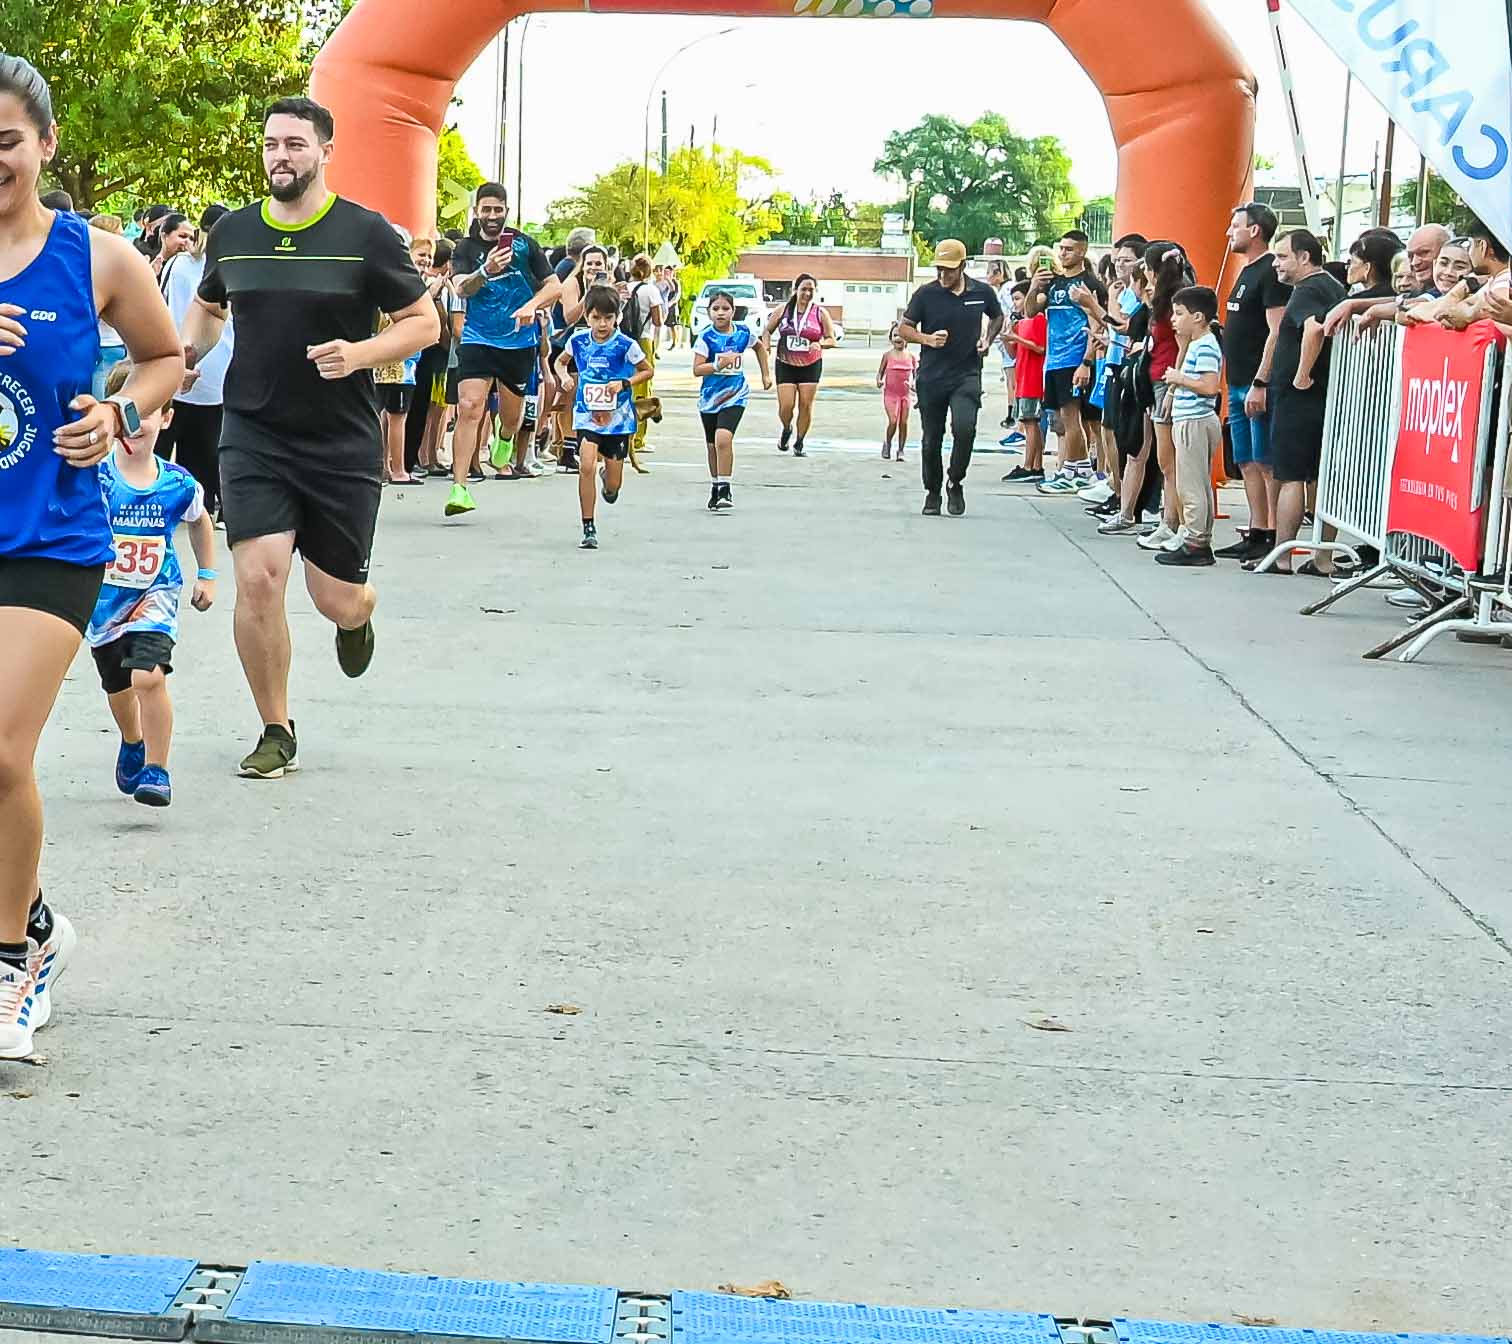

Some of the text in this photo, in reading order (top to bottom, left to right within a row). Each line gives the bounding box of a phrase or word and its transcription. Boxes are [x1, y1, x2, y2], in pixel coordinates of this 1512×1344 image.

[30, 310, 57, 322] GDO
[1405, 357, 1469, 455] moplex
[112, 516, 165, 528] MALVINAS
[106, 540, 160, 575] 35
